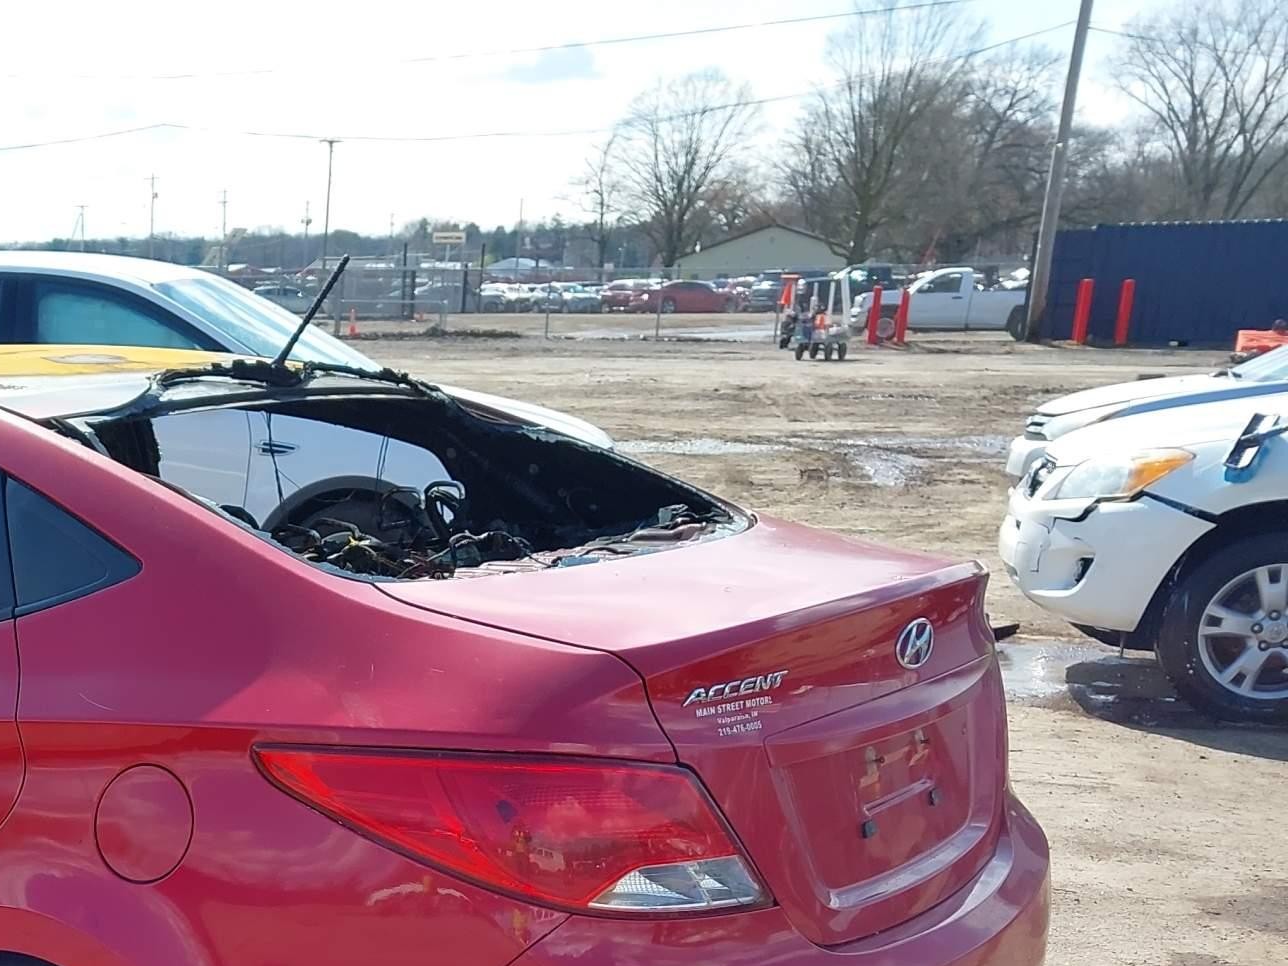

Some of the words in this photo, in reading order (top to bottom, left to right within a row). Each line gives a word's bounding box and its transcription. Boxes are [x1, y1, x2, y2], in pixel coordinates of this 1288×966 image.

[682, 669, 789, 708] ACCENT
[696, 707, 716, 718] MAIN
[717, 700, 745, 714] STREET
